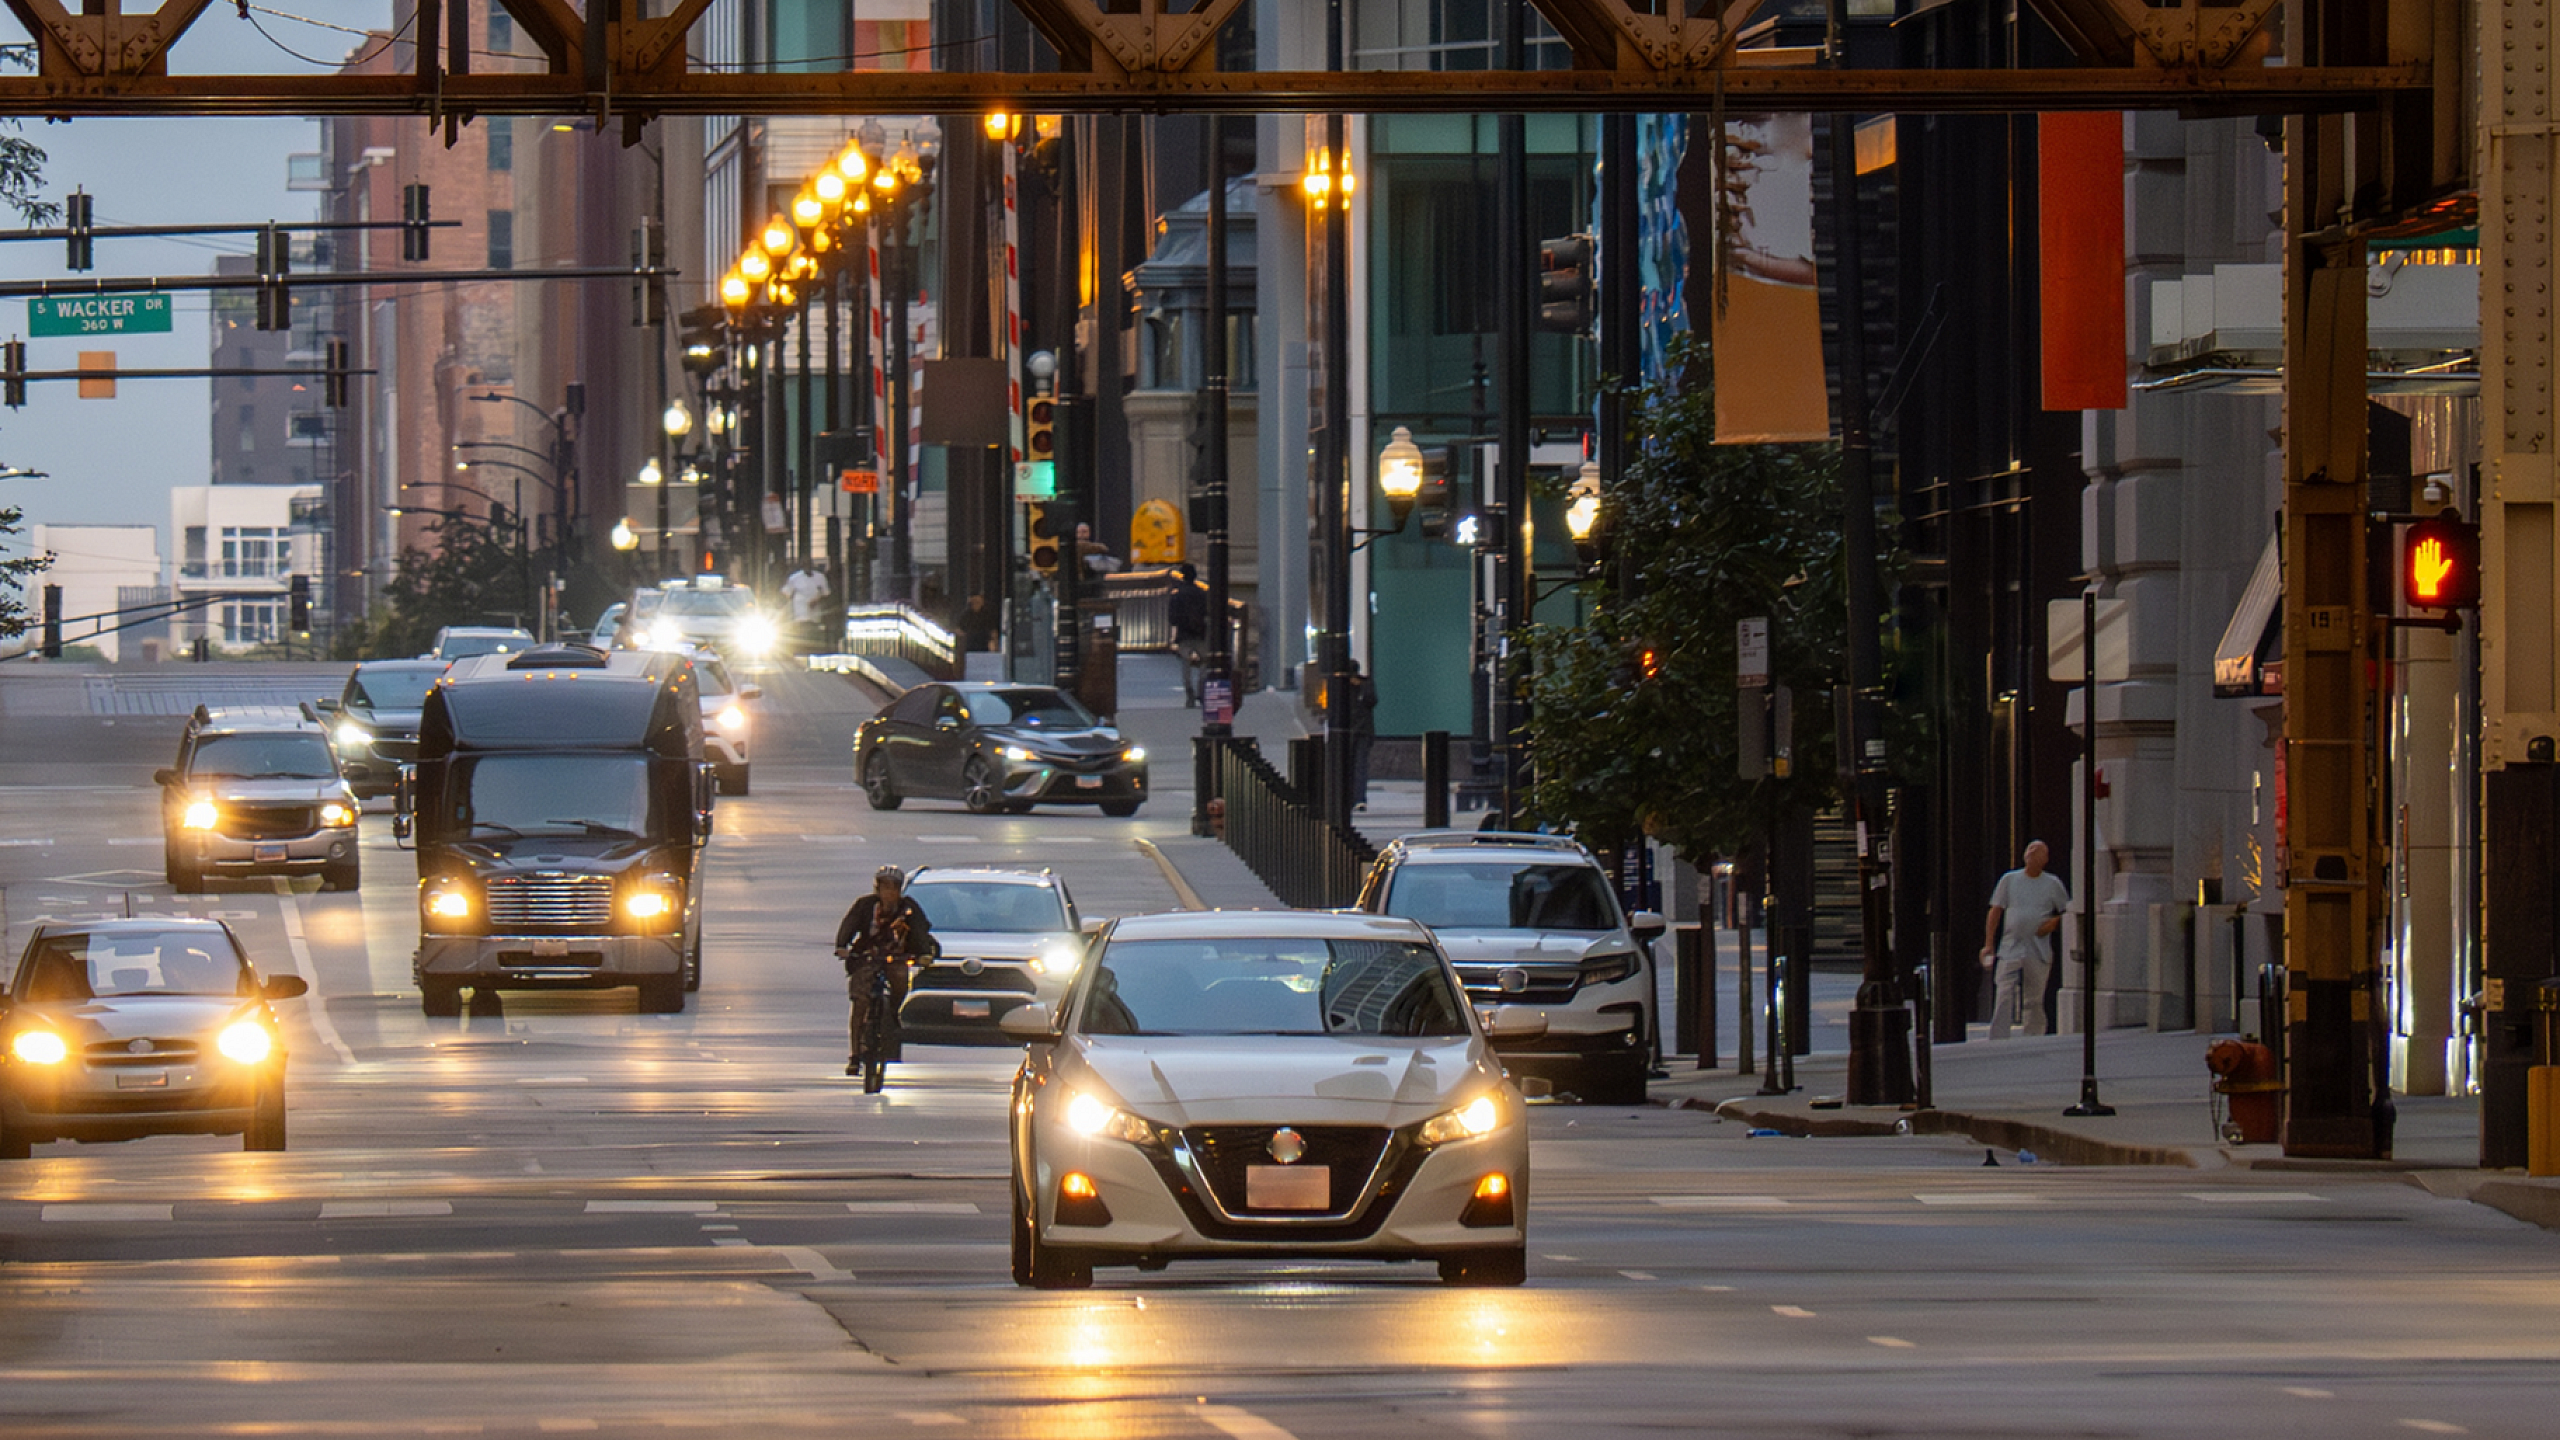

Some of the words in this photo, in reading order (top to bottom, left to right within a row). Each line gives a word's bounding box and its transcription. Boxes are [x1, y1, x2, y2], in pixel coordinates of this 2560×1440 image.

[37, 302, 46, 314] S
[57, 299, 135, 318] WACKER
[145, 299, 163, 310] DR
[81, 319, 108, 331] 360
[113, 318, 123, 330] W
